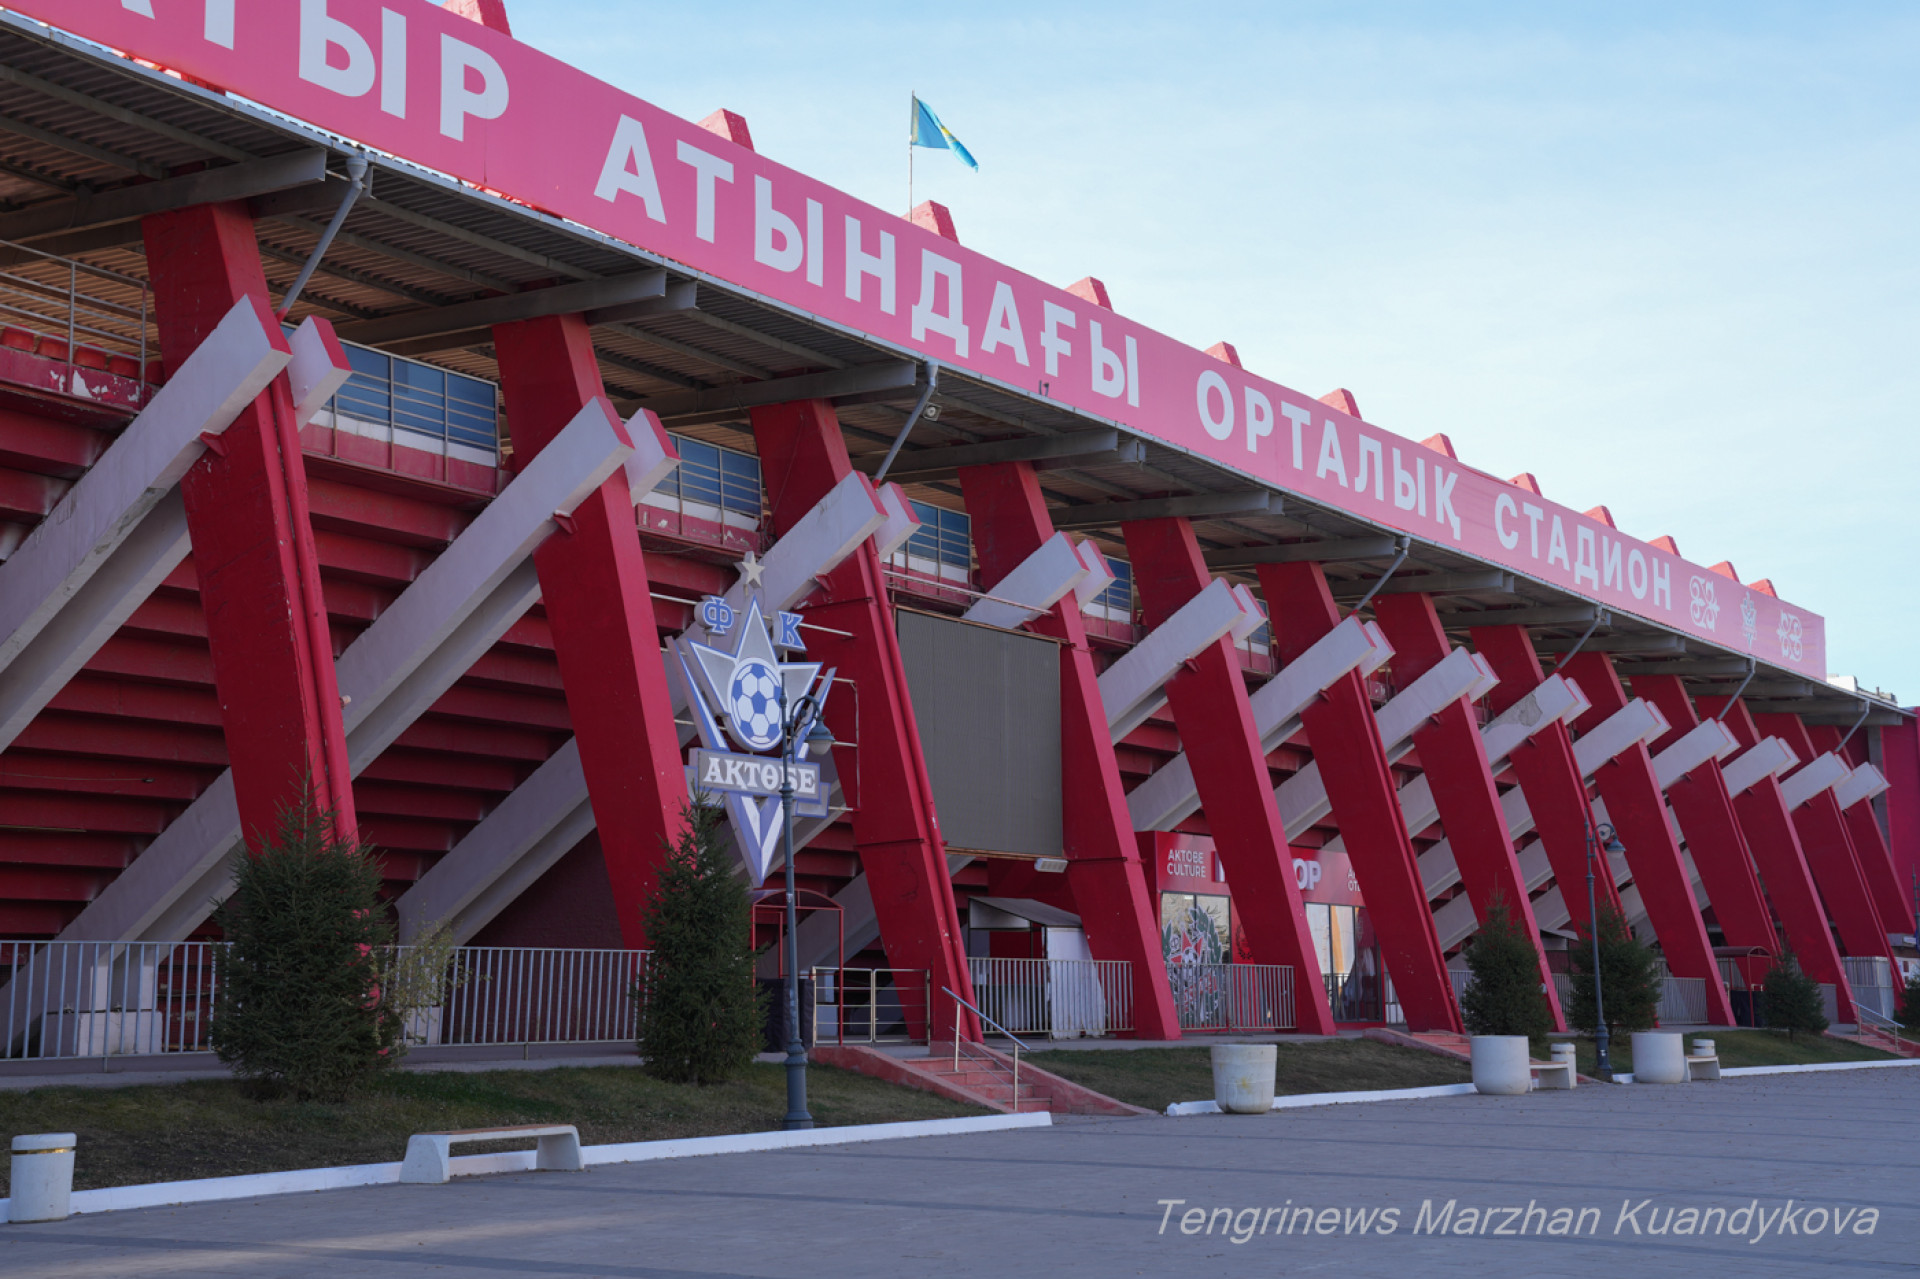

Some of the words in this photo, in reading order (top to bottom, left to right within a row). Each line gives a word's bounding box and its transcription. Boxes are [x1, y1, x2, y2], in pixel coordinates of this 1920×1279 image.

[593, 113, 1140, 409] АТЫНДАҒЫ
[1196, 370, 1462, 541] ОРТАЛЫҚ
[1494, 492, 1672, 611] СТАДИОН
[703, 595, 733, 635] Ф
[1166, 862, 1207, 878] CULTURE
[1167, 849, 1205, 865] AKTOBE
